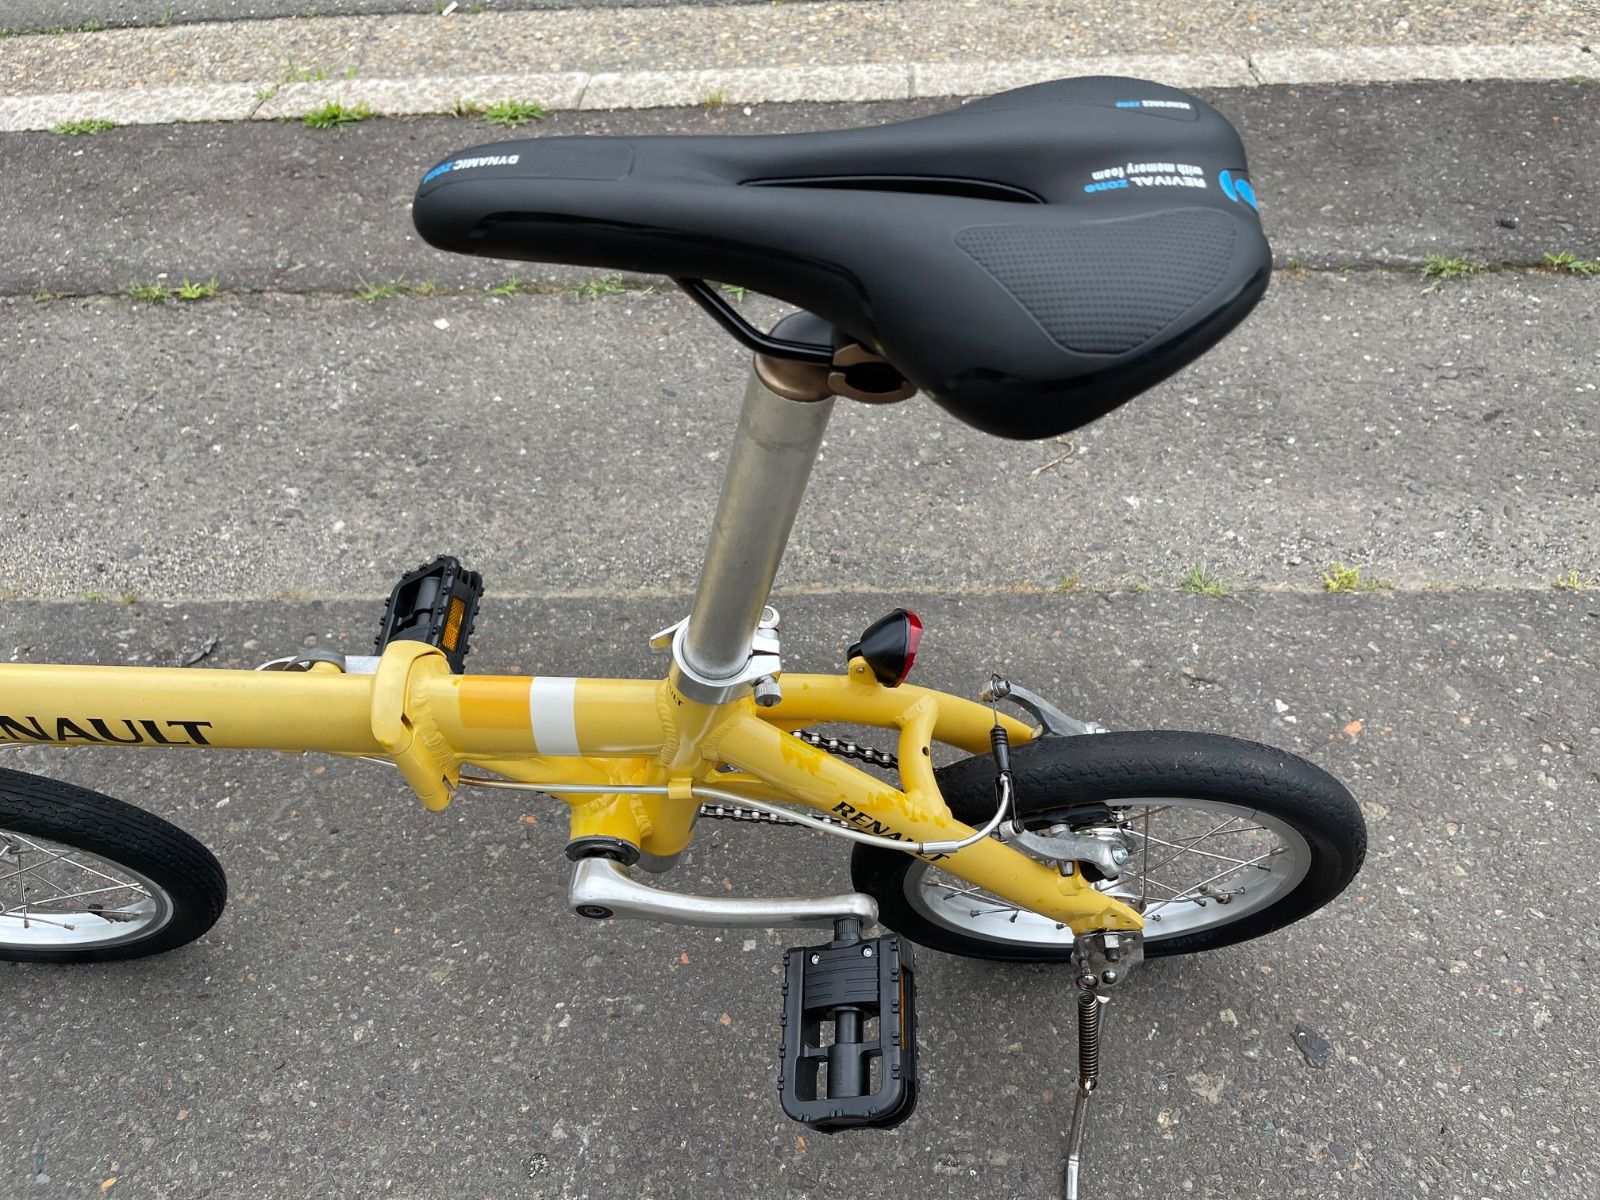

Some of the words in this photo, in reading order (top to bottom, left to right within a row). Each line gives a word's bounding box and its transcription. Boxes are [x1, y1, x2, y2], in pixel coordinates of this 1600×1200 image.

[453, 154, 520, 171] DYNAMIC
[1126, 162, 1176, 175] memory
[1176, 163, 1204, 176] with
[1091, 166, 1125, 181] foam
[1083, 178, 1130, 193] zone
[1129, 176, 1207, 189] REVIVAL
[0, 715, 213, 745] NAULT
